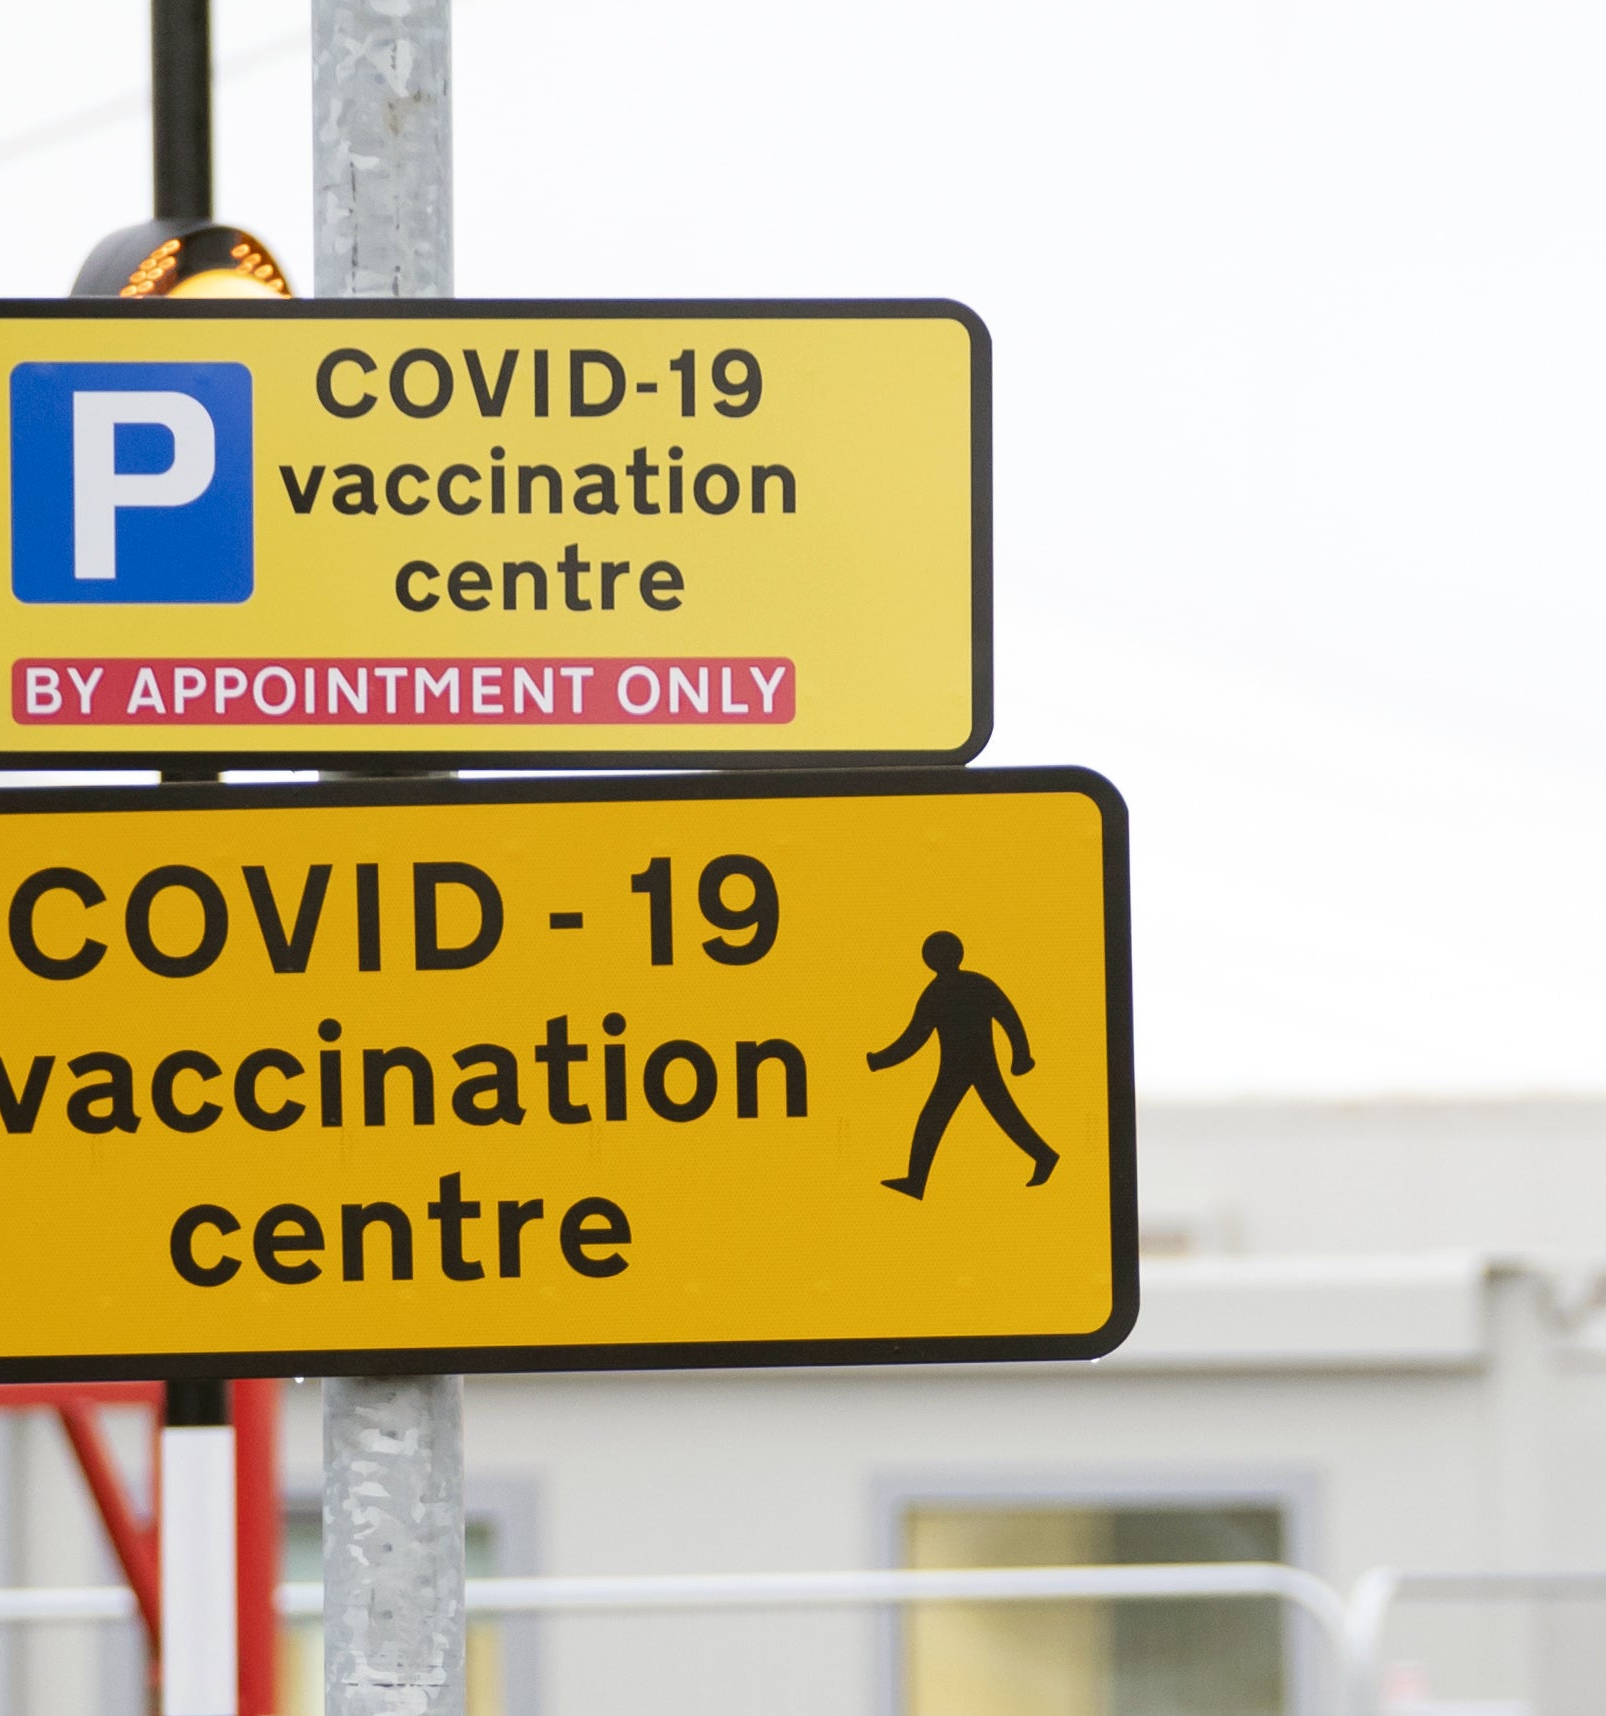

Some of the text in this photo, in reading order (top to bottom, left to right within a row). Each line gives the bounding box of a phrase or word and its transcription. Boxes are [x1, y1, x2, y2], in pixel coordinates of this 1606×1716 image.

[315, 347, 764, 420] COVID-19
[71, 390, 217, 581] P
[278, 444, 797, 517] vaccination
[394, 543, 685, 614] centre
[25, 665, 788, 716] BY APPOINTMENT ONLY
[7, 860, 505, 982] COVID
[629, 853, 781, 967] 19
[168, 1170, 633, 1289] centre
